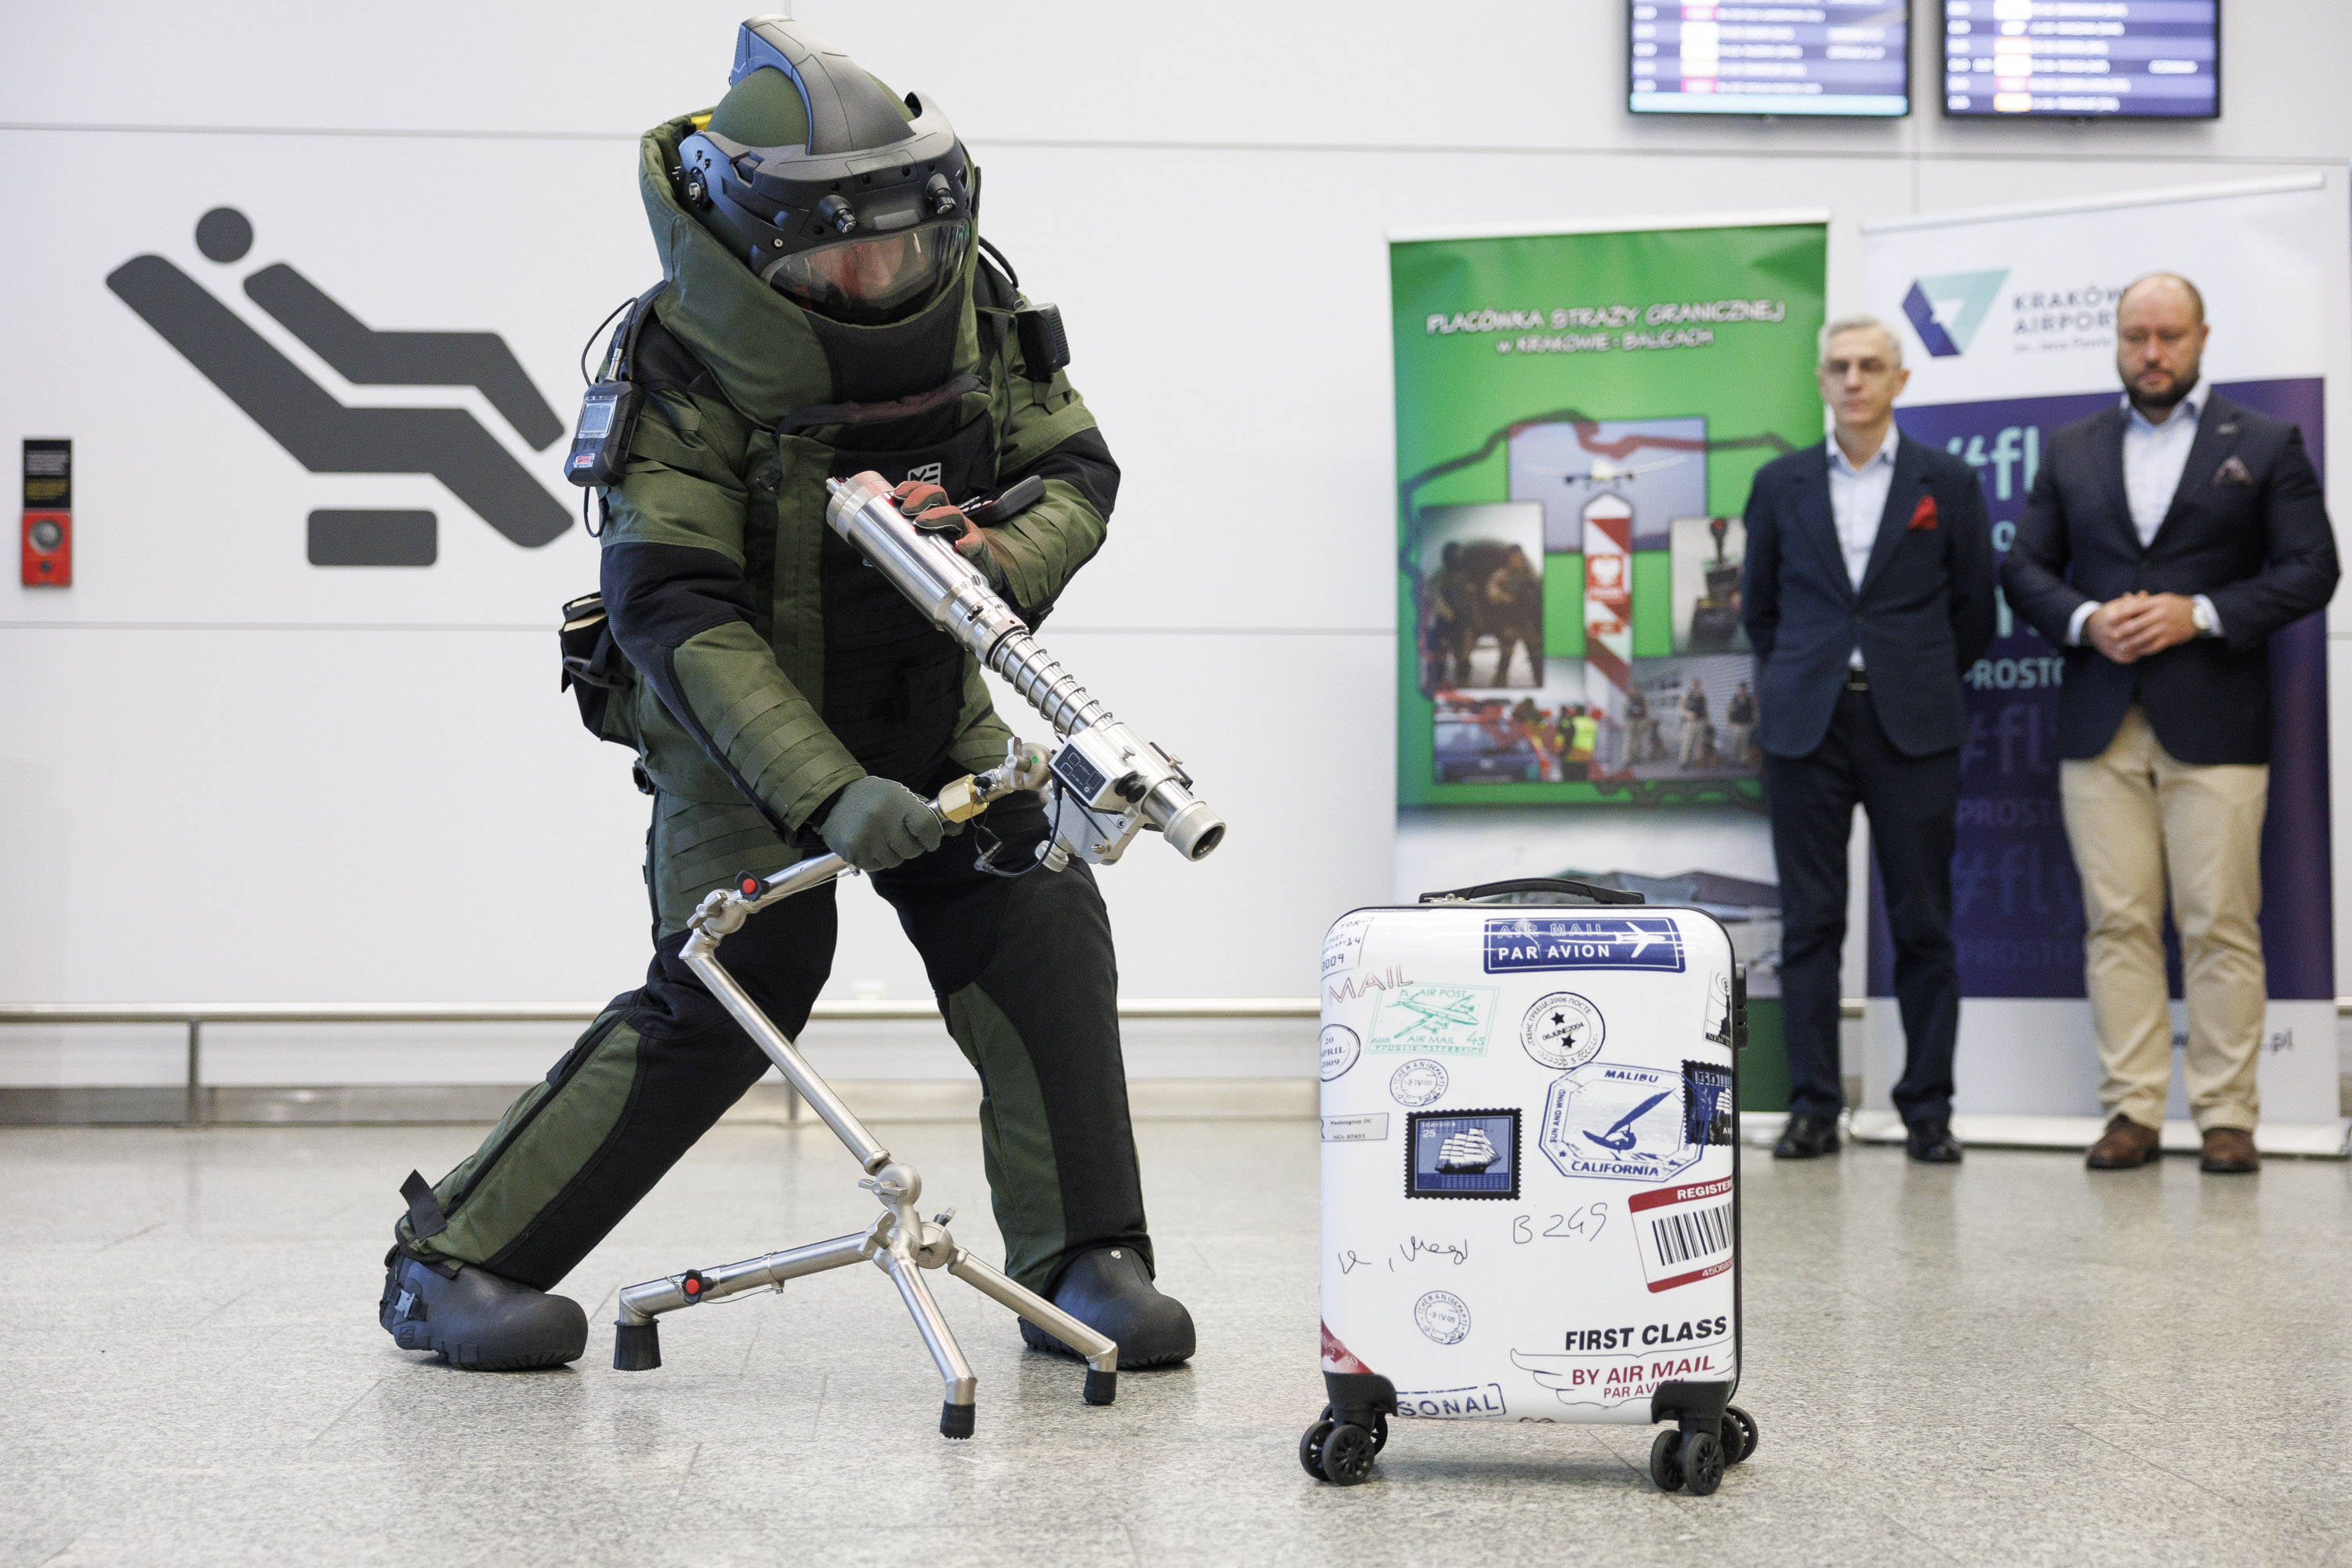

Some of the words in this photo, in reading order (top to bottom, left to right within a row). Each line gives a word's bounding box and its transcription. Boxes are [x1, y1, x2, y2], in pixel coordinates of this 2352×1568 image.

[2014, 310, 2111, 334] AIRPOR
[1497, 923, 1538, 938] AIR
[1550, 922, 1604, 937] MAIL
[1498, 946, 1538, 960] PAR
[1548, 944, 1610, 959] AVION
[1329, 964, 1414, 1005] MAIL
[1439, 989, 1467, 998] POST
[1604, 1069, 1659, 1083] MALIBU
[1556, 1089, 1566, 1109] WIND
[1553, 1110, 1562, 1127] AND
[1422, 1129, 1436, 1138] 25
[1549, 1127, 1558, 1144] SUN
[1570, 1161, 1660, 1177] CALIFORNIA
[1565, 1327, 1635, 1351] FIRST
[1642, 1316, 1727, 1345] CLASS
[1572, 1369, 1599, 1385] BY
[1606, 1365, 1643, 1385] AIR
[1651, 1355, 1715, 1379] MAIL
[1603, 1386, 1630, 1399] PAR
